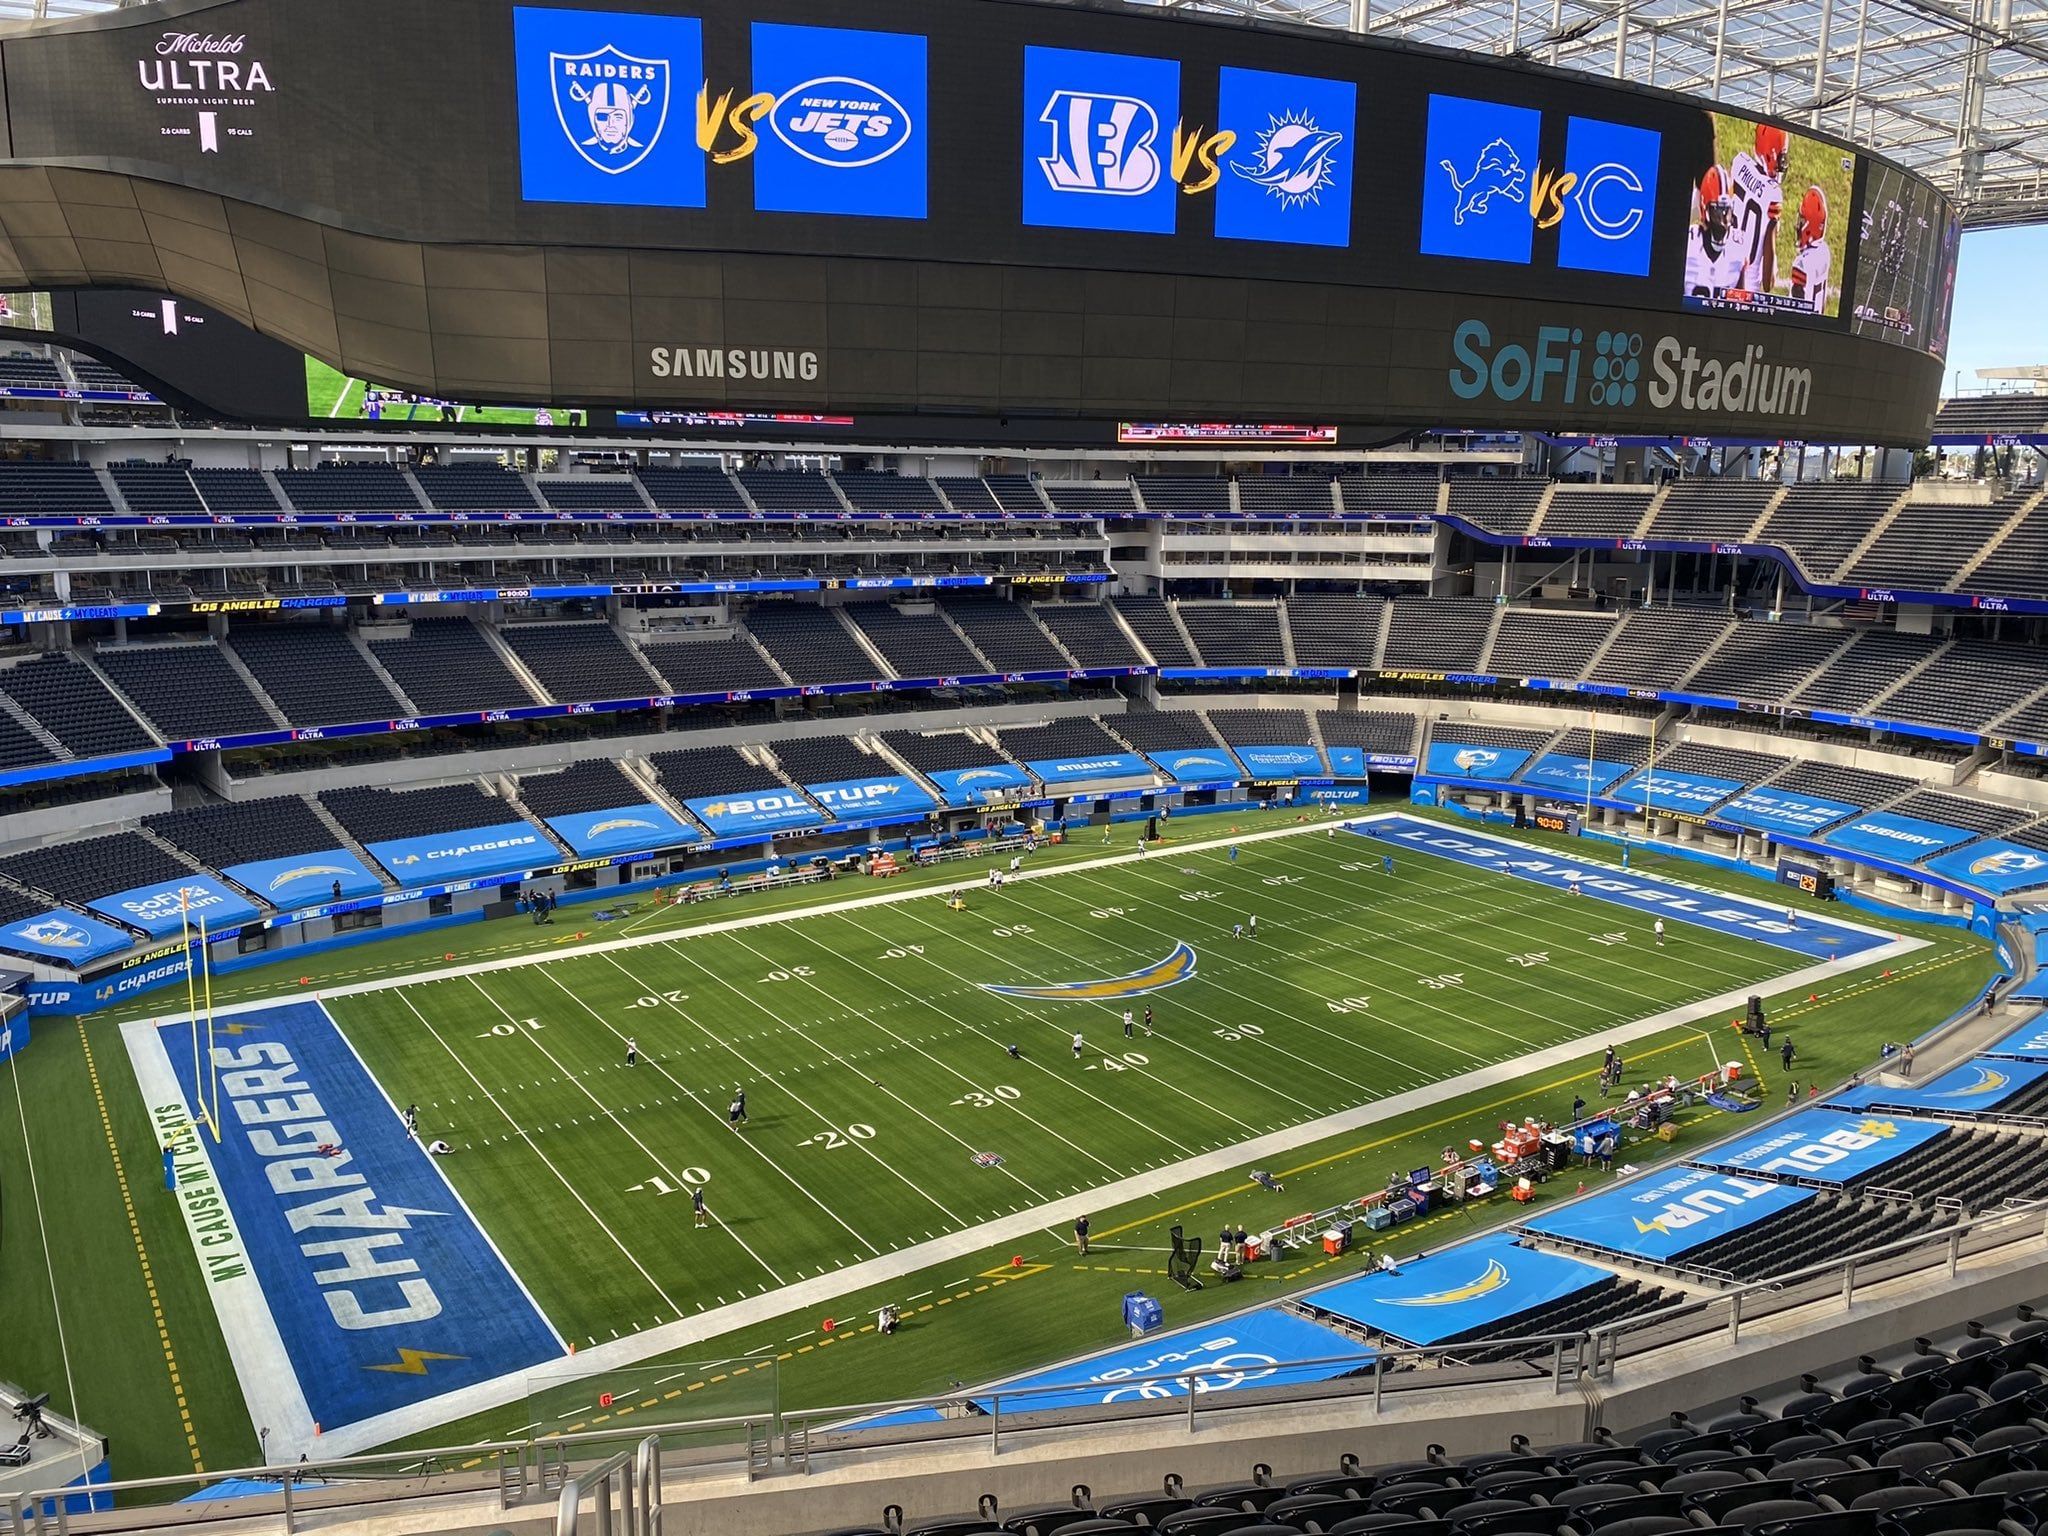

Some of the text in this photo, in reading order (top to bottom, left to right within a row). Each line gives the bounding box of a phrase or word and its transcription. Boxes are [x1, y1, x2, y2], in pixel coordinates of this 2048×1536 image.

[155, 32, 247, 55] Michelob
[139, 60, 275, 91] ULTRA
[565, 62, 656, 80] RAIDERS
[800, 98, 882, 112] NEW YORK
[696, 78, 776, 165] VS
[789, 112, 892, 137] JETS
[1170, 115, 1236, 195] VS
[1738, 164, 1763, 198] PHILLIPS
[1529, 159, 1578, 229] VS
[651, 347, 819, 380] SAMSUNG
[1448, 319, 1812, 416] SoFi Stadium
[1622, 543, 1646, 551] ULTRA
[1717, 547, 1742, 555] ULTRA
[192, 596, 346, 612] LOS ANGELES CHARGERS
[408, 592, 420, 602] MY
[420, 592, 440, 602] CAUSE
[1868, 593, 1895, 602] ULTRA
[24, 606, 118, 622] MY CAUSE MY CLEATS
[1979, 601, 2008, 611] ULTRA
[1008, 674, 1024, 682] ULTRA
[1132, 668, 1148, 676] ULTRA
[1399, 672, 1445, 680] ANGELES
[1445, 674, 1498, 684] CHARGERS
[943, 678, 960, 686] ULTRA
[655, 699, 675, 708] ULTRA
[732, 693, 752, 701] ULTRA
[487, 714, 510, 722] ULTRA
[573, 706, 594, 714] ULTRA
[396, 721, 419, 731] ULTRA
[298, 732, 324, 741] ULTRA
[1992, 738, 2003, 747] 25
[194, 742, 221, 752] ULTRA
[1370, 755, 1414, 764] #BOLTUP
[1267, 780, 1298, 788] ANGELES
[1632, 784, 1722, 802] FOR ONE
[976, 806, 988, 814] LOS
[988, 803, 1020, 813] ANGELES
[1728, 800, 1828, 823] ANOTHER
[1780, 802, 1846, 816] TO BE
[1536, 816, 1564, 830] 90:00
[1658, 810, 1745, 834] LOS ANGELES CHARGERS
[1852, 824, 1944, 846] SUBWAY
[392, 836, 536, 865] LA CHARGERS
[552, 852, 654, 874] LOS ANGELES CHARGERS
[1394, 831, 1806, 932] LOS ANGELES
[1802, 876, 1815, 890] 25
[122, 892, 184, 912] SoFi
[383, 892, 423, 904] #BOLTUP
[138, 895, 224, 920] Stadium
[1090, 907, 1124, 918] 40
[992, 924, 1036, 938] 50
[1587, 932, 1628, 946] 10
[122, 928, 242, 970] LOS ANGELES CHARGERS
[886, 944, 924, 958] 40
[1506, 952, 1550, 968] 20
[768, 965, 816, 981] 30
[96, 962, 193, 1001] LA CHARGERS
[1418, 974, 1464, 990] 30
[28, 992, 71, 1006] TUP
[637, 990, 690, 1008] 20
[1326, 997, 1369, 1014] 40
[492, 1017, 546, 1036] 10
[1212, 1023, 1264, 1042] 50
[1102, 1052, 1150, 1072] 40
[964, 1085, 1022, 1108] 30
[813, 1123, 876, 1150] 20
[208, 1042, 455, 1331] CHARGERS
[644, 1166, 712, 1196] 10
[184, 1186, 234, 1246] CAUSE
[1254, 1244, 1260, 1255] G
[1335, 1240, 1342, 1250] G
[206, 1253, 247, 1283] MY
